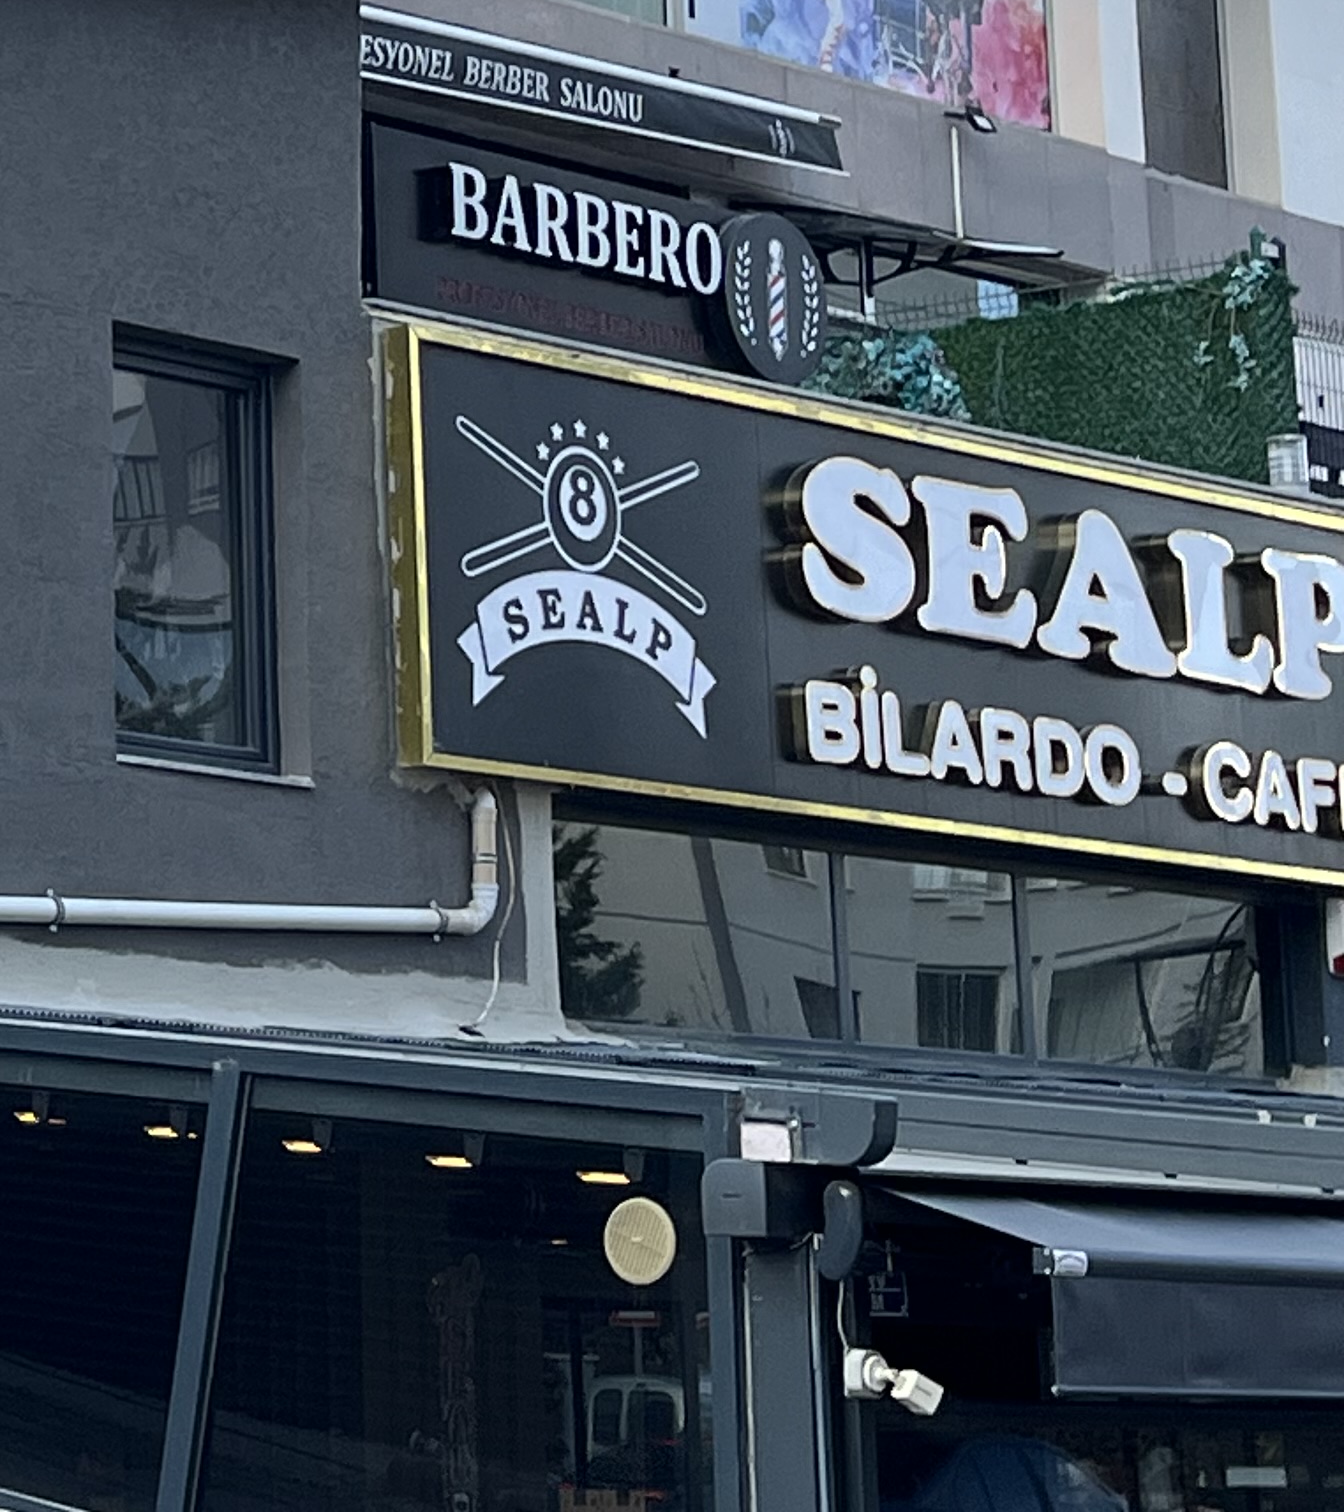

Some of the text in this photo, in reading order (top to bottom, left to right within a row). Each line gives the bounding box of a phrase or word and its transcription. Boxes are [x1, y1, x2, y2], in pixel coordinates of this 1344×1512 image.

[462, 55, 551, 103] BERBER
[560, 76, 645, 123] SALONU
[448, 161, 723, 296] BARBERO
[568, 468, 598, 527] 8
[501, 587, 673, 660] SEALP
[801, 455, 1344, 701] SEALP
[804, 663, 1142, 806] BİLARDO
[1203, 740, 1344, 833] CAF
